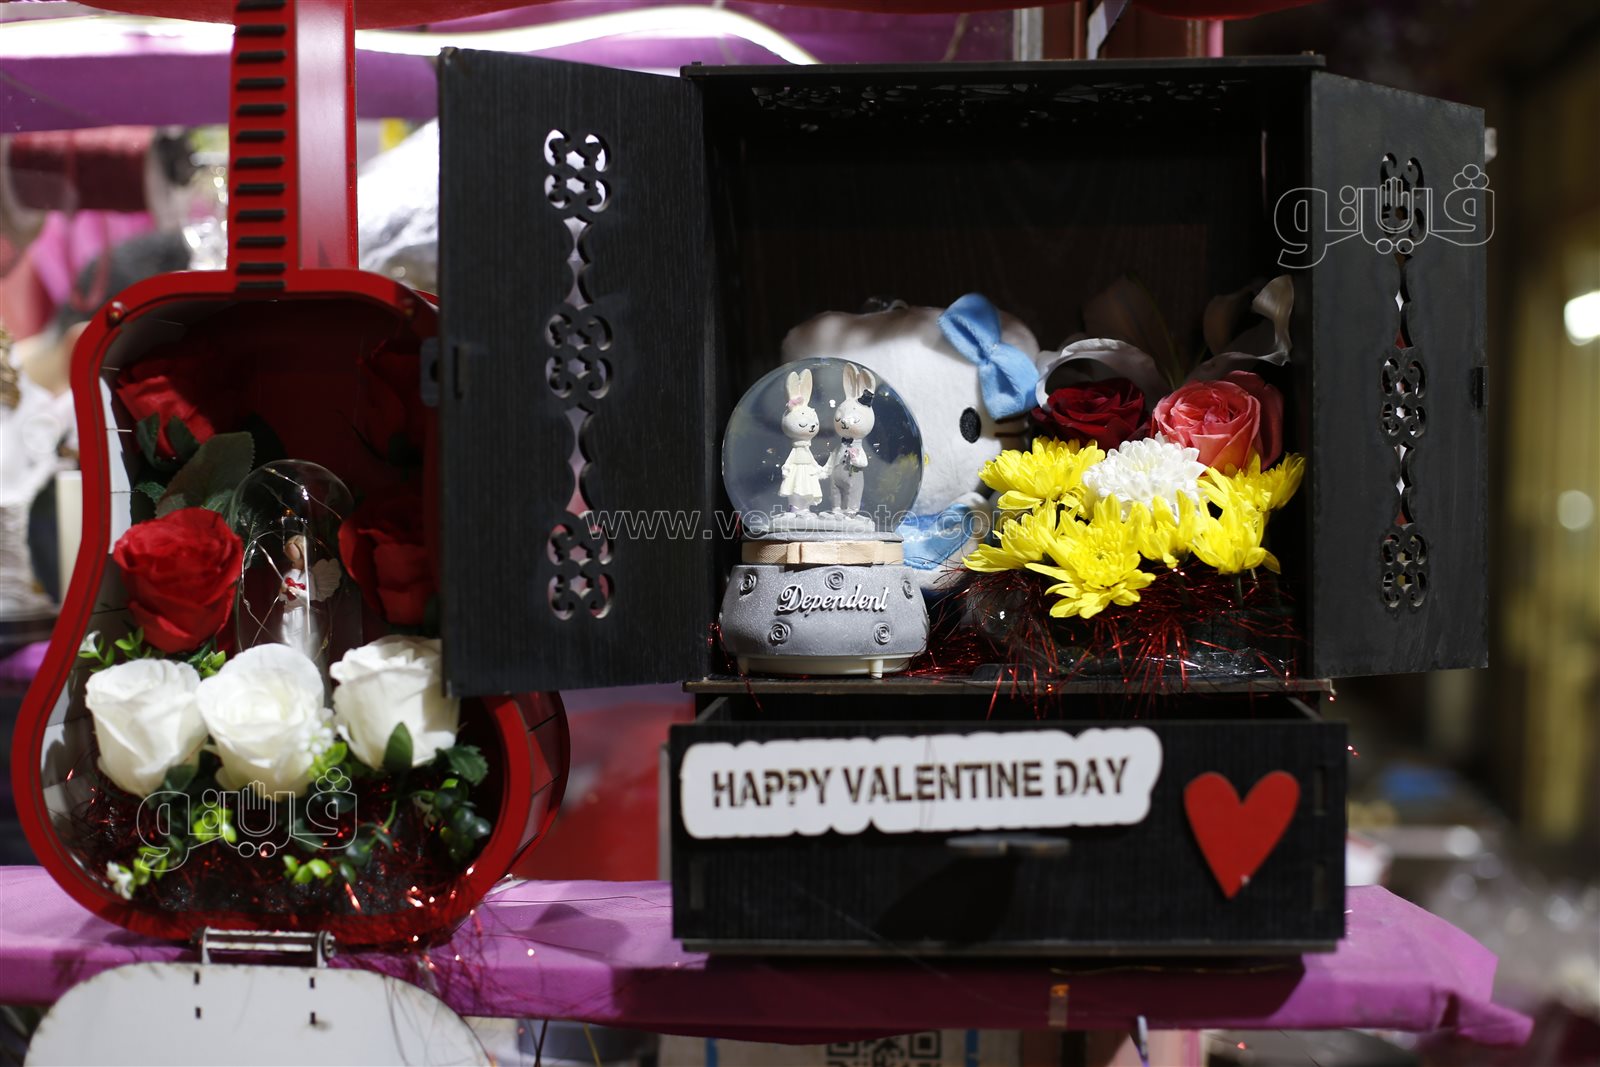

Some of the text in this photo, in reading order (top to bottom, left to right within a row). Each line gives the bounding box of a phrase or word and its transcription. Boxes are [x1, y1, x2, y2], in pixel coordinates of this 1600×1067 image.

[777, 583, 890, 617] Dependent
[712, 756, 1129, 808] HAPPY VALENTINE DAY
